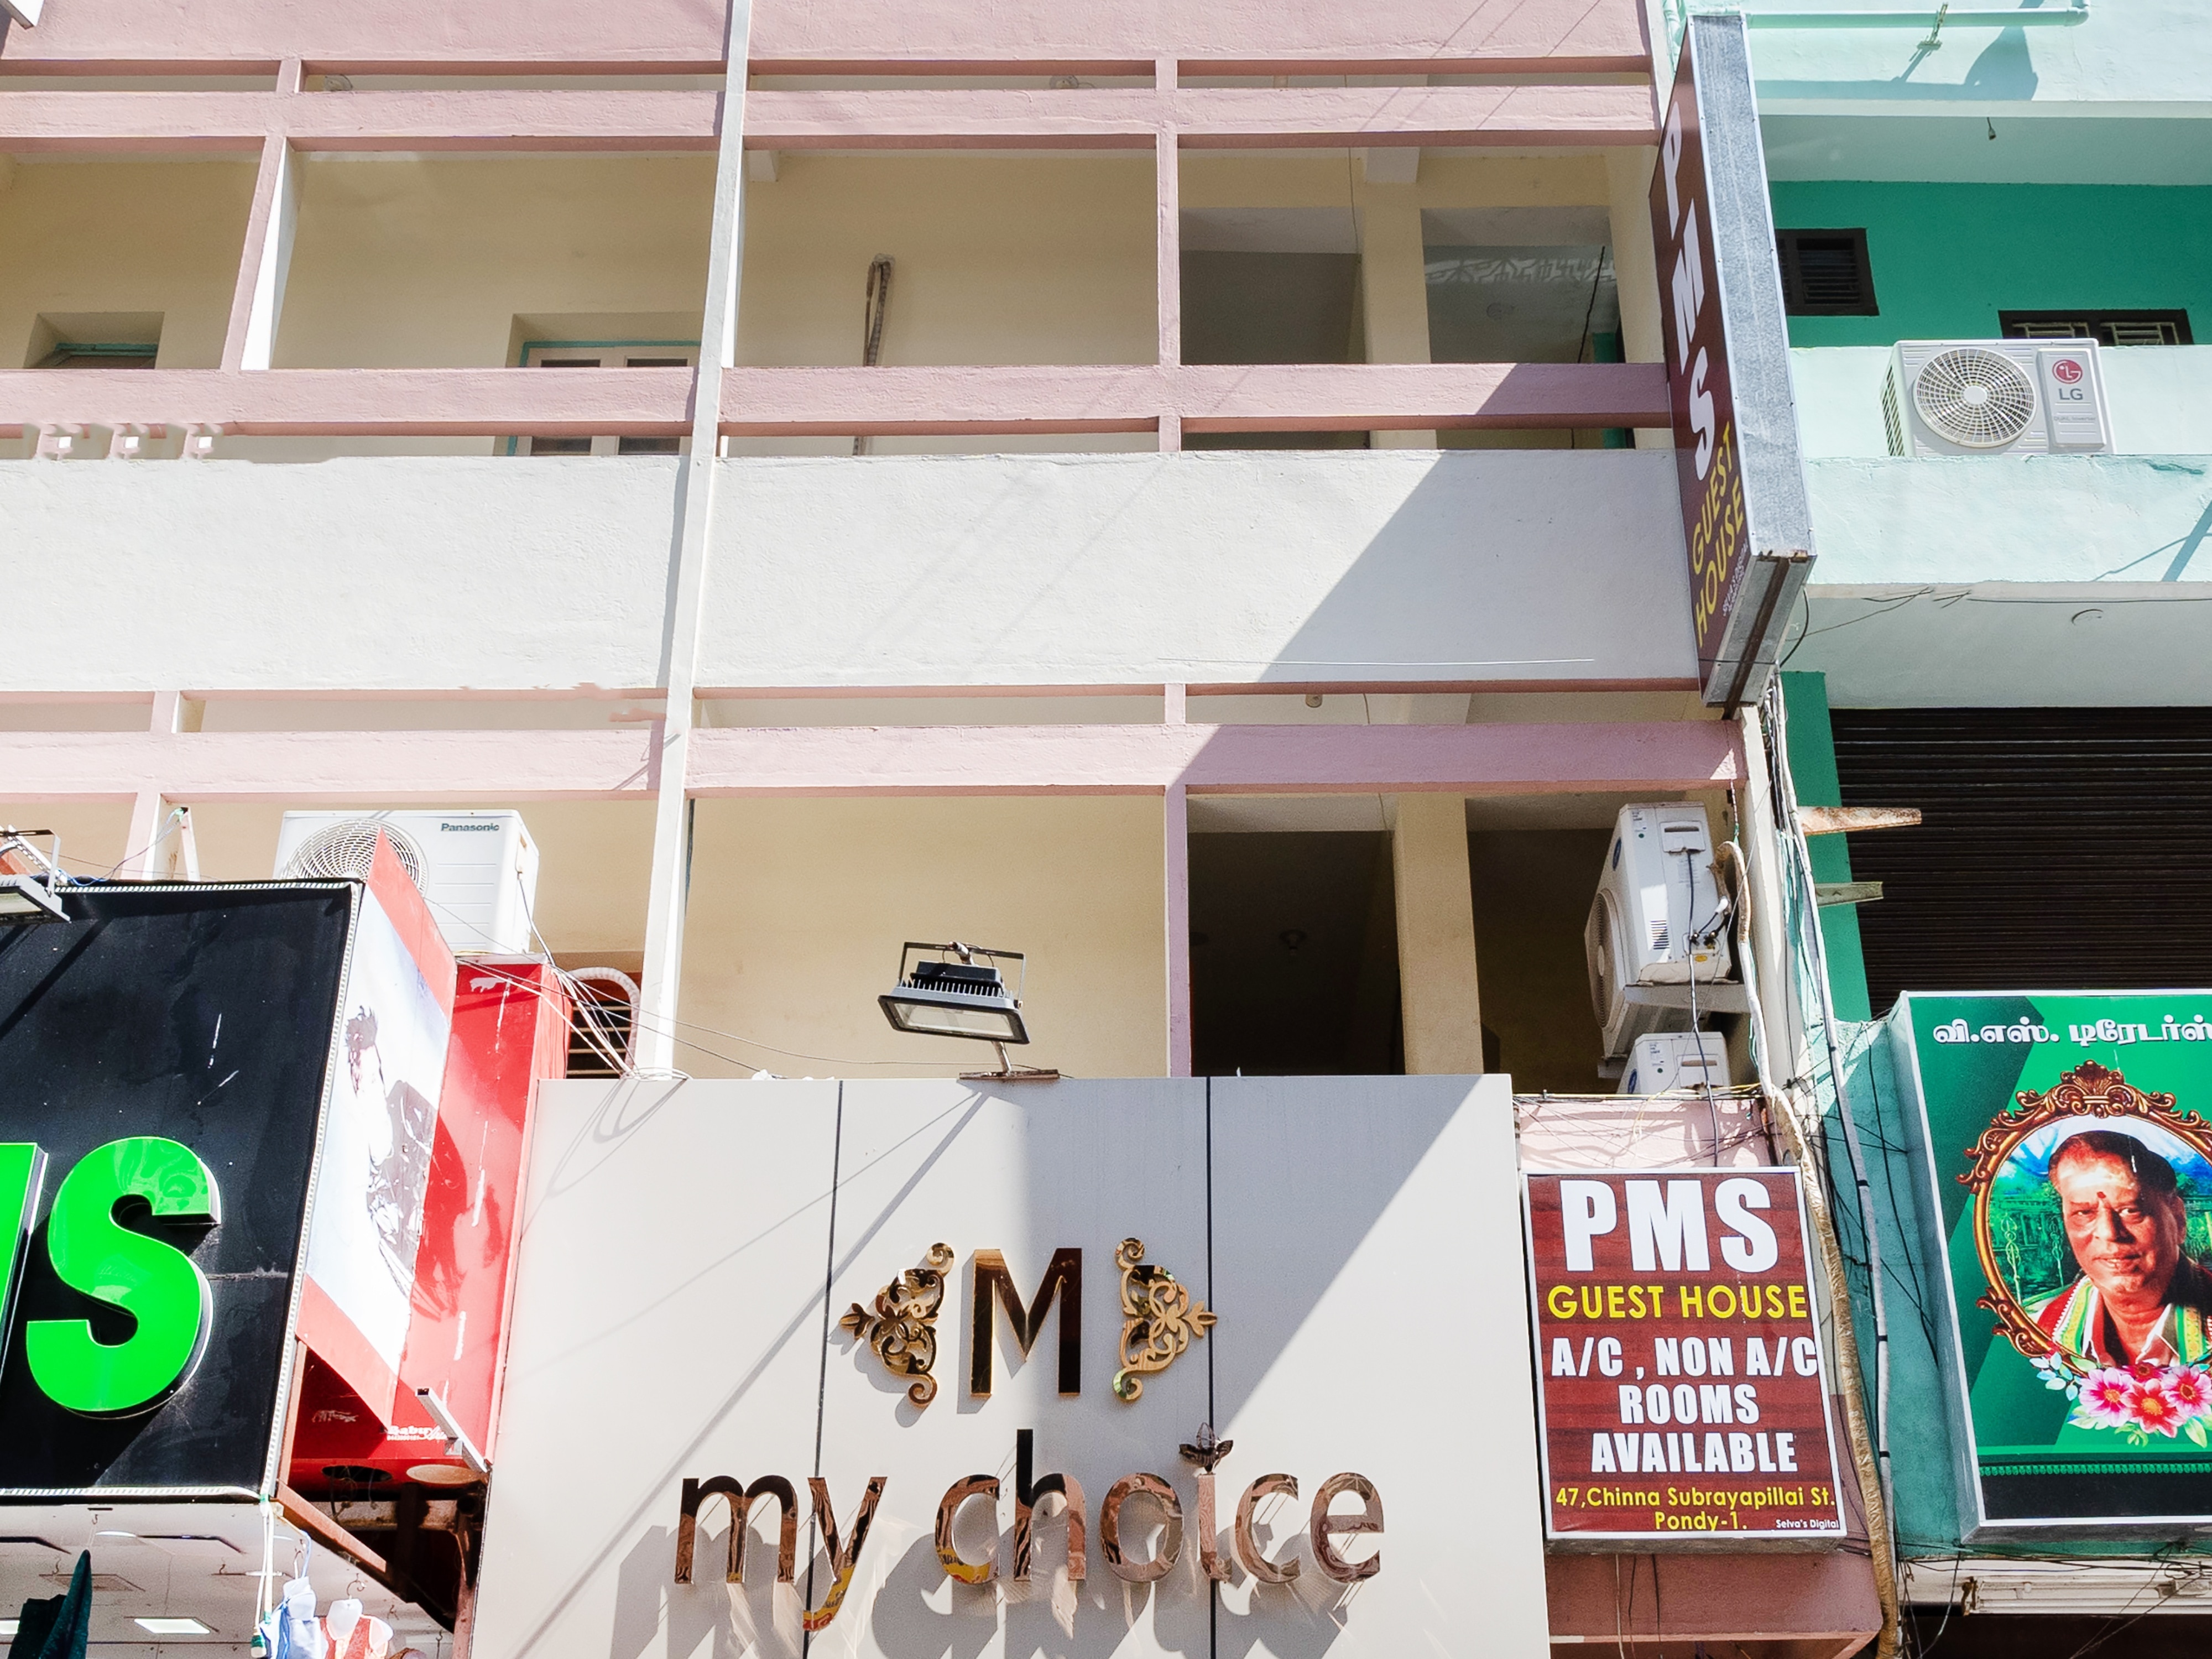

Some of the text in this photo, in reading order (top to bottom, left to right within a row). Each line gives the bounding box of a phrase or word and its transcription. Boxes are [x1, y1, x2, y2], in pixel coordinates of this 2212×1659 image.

[2058, 388, 2084, 400] LG
[1692, 421, 1733, 575] GUEST
[1696, 476, 1744, 648] HOUSE
[441, 822, 500, 832] Panasonic
[1559, 1177, 1778, 1273] PMS
[969, 1248, 1082, 1397] M
[1547, 1285, 1807, 1319] GUEST HOUSE
[1551, 1336, 1624, 1377] A/C
[1654, 1336, 1735, 1377] NON
[1745, 1336, 1818, 1377] A/C
[1618, 1384, 1760, 1425] ROOMS
[1590, 1432, 1798, 1473] AVAILABLE
[1556, 1486, 1836, 1510] 47,Chinna Subrayapillai St.
[674, 1426, 1384, 1632] my choice
[1655, 1510, 1747, 1531] Pondy-1.
[1776, 1519, 1840, 1530] Selva's Digital
